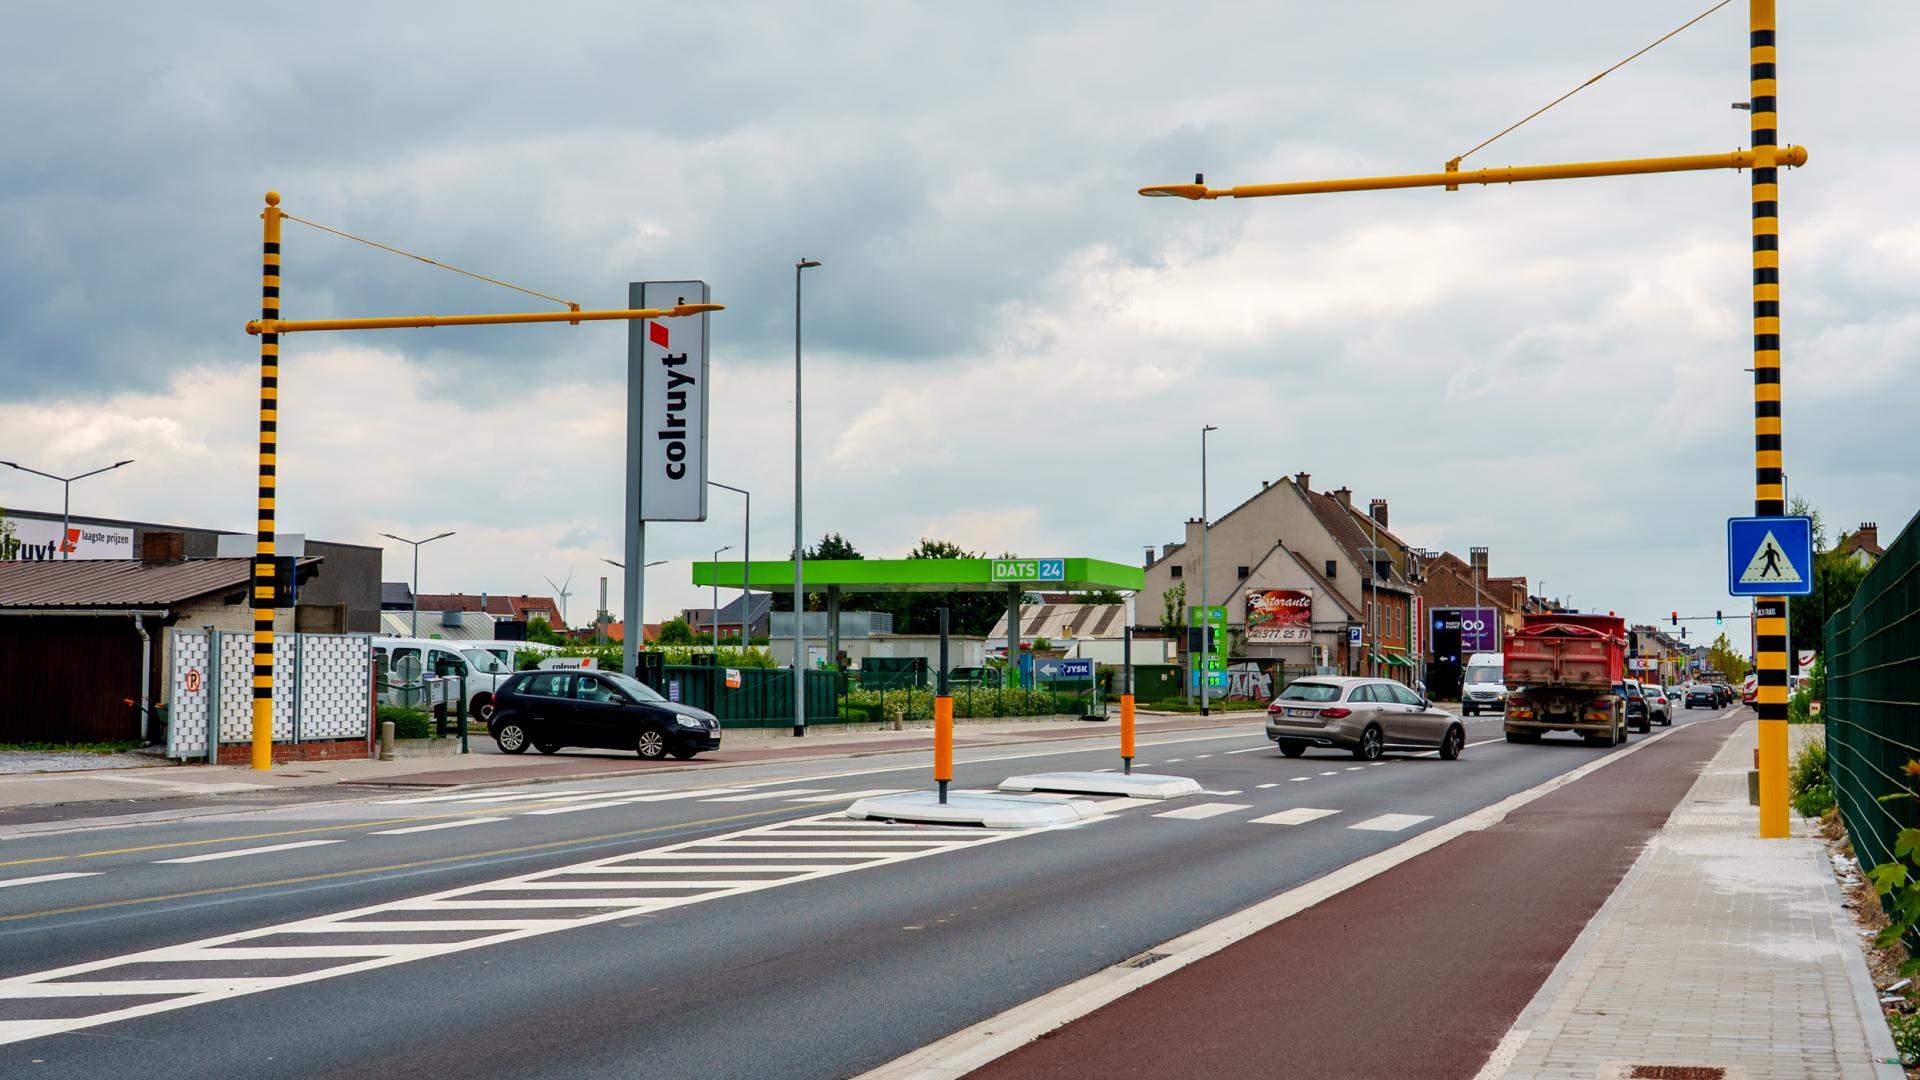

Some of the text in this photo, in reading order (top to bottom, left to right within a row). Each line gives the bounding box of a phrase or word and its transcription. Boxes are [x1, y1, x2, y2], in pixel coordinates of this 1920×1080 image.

[658, 353, 695, 480] colruyt
[82, 530, 128, 545] laagste prijzen
[997, 563, 1060, 576] DATS 24
[1066, 665, 1088, 673] JYSK
